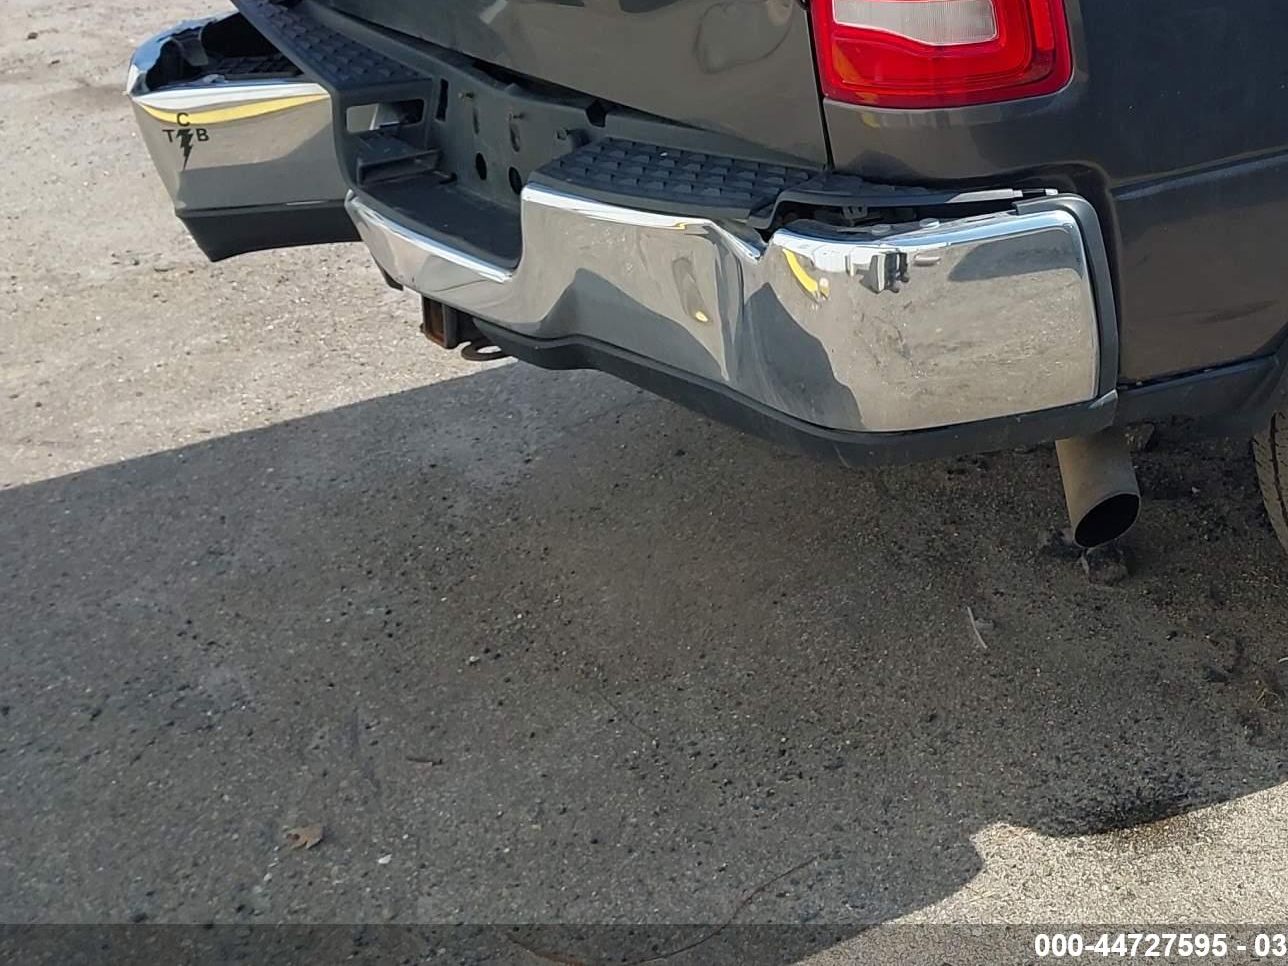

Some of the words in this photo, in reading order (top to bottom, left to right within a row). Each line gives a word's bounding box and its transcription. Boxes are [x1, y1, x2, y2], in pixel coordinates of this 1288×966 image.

[176, 112, 190, 127] C
[162, 128, 175, 143] T
[196, 128, 210, 142] B
